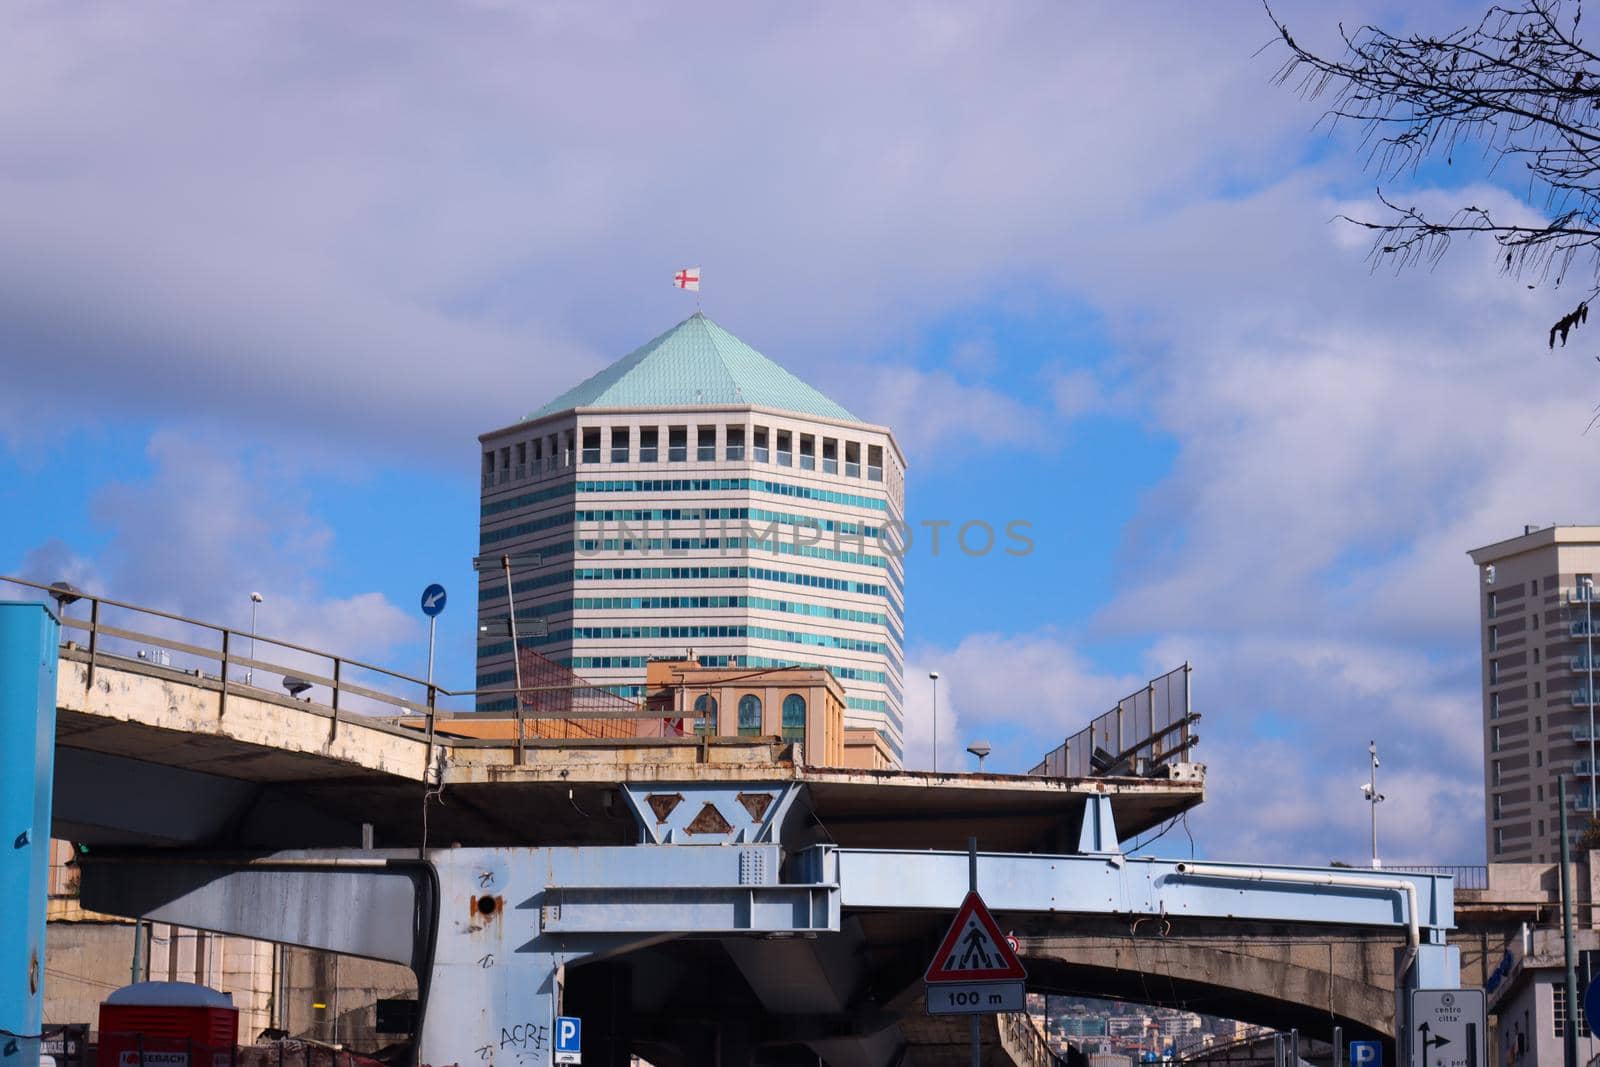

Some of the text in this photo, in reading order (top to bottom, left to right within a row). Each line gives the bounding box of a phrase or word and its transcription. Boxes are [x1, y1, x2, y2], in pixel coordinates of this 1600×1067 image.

[948, 991, 1002, 1006] 100 m
[1435, 1006, 1462, 1014] centro
[561, 1020, 576, 1048] P
[1356, 1045, 1376, 1067] P
